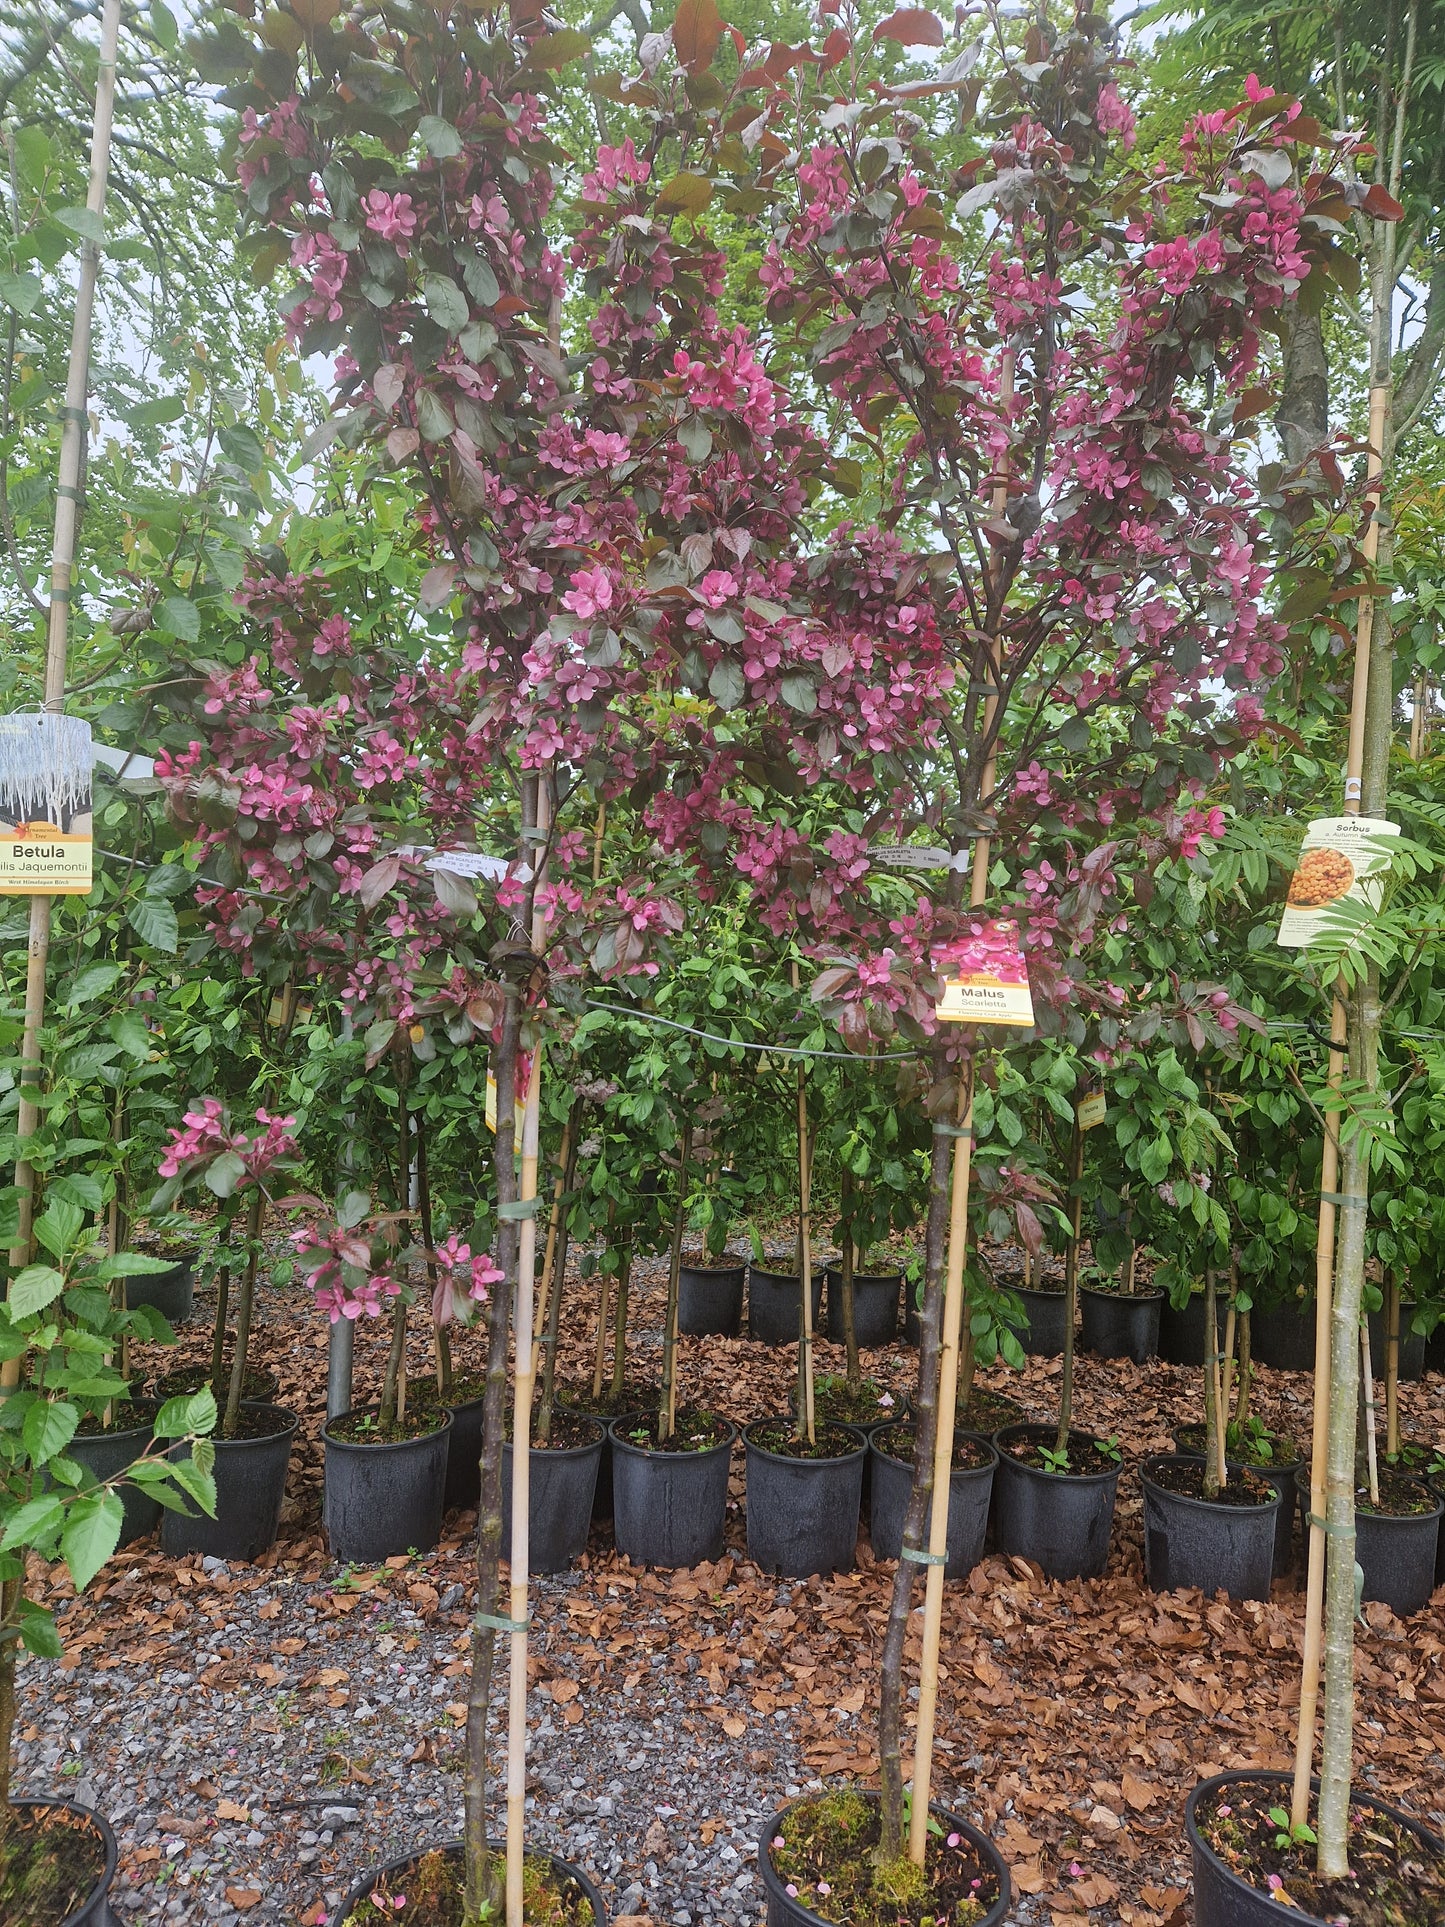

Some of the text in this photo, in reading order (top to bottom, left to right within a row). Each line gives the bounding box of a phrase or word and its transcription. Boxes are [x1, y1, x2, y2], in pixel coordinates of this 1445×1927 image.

[1336, 824, 1371, 833] Sorbus
[13, 845, 65, 858] Betula
[18, 862, 88, 873] Jaquemontii
[961, 988, 1005, 998] Malus
[961, 999, 1007, 1008] Scarletta
